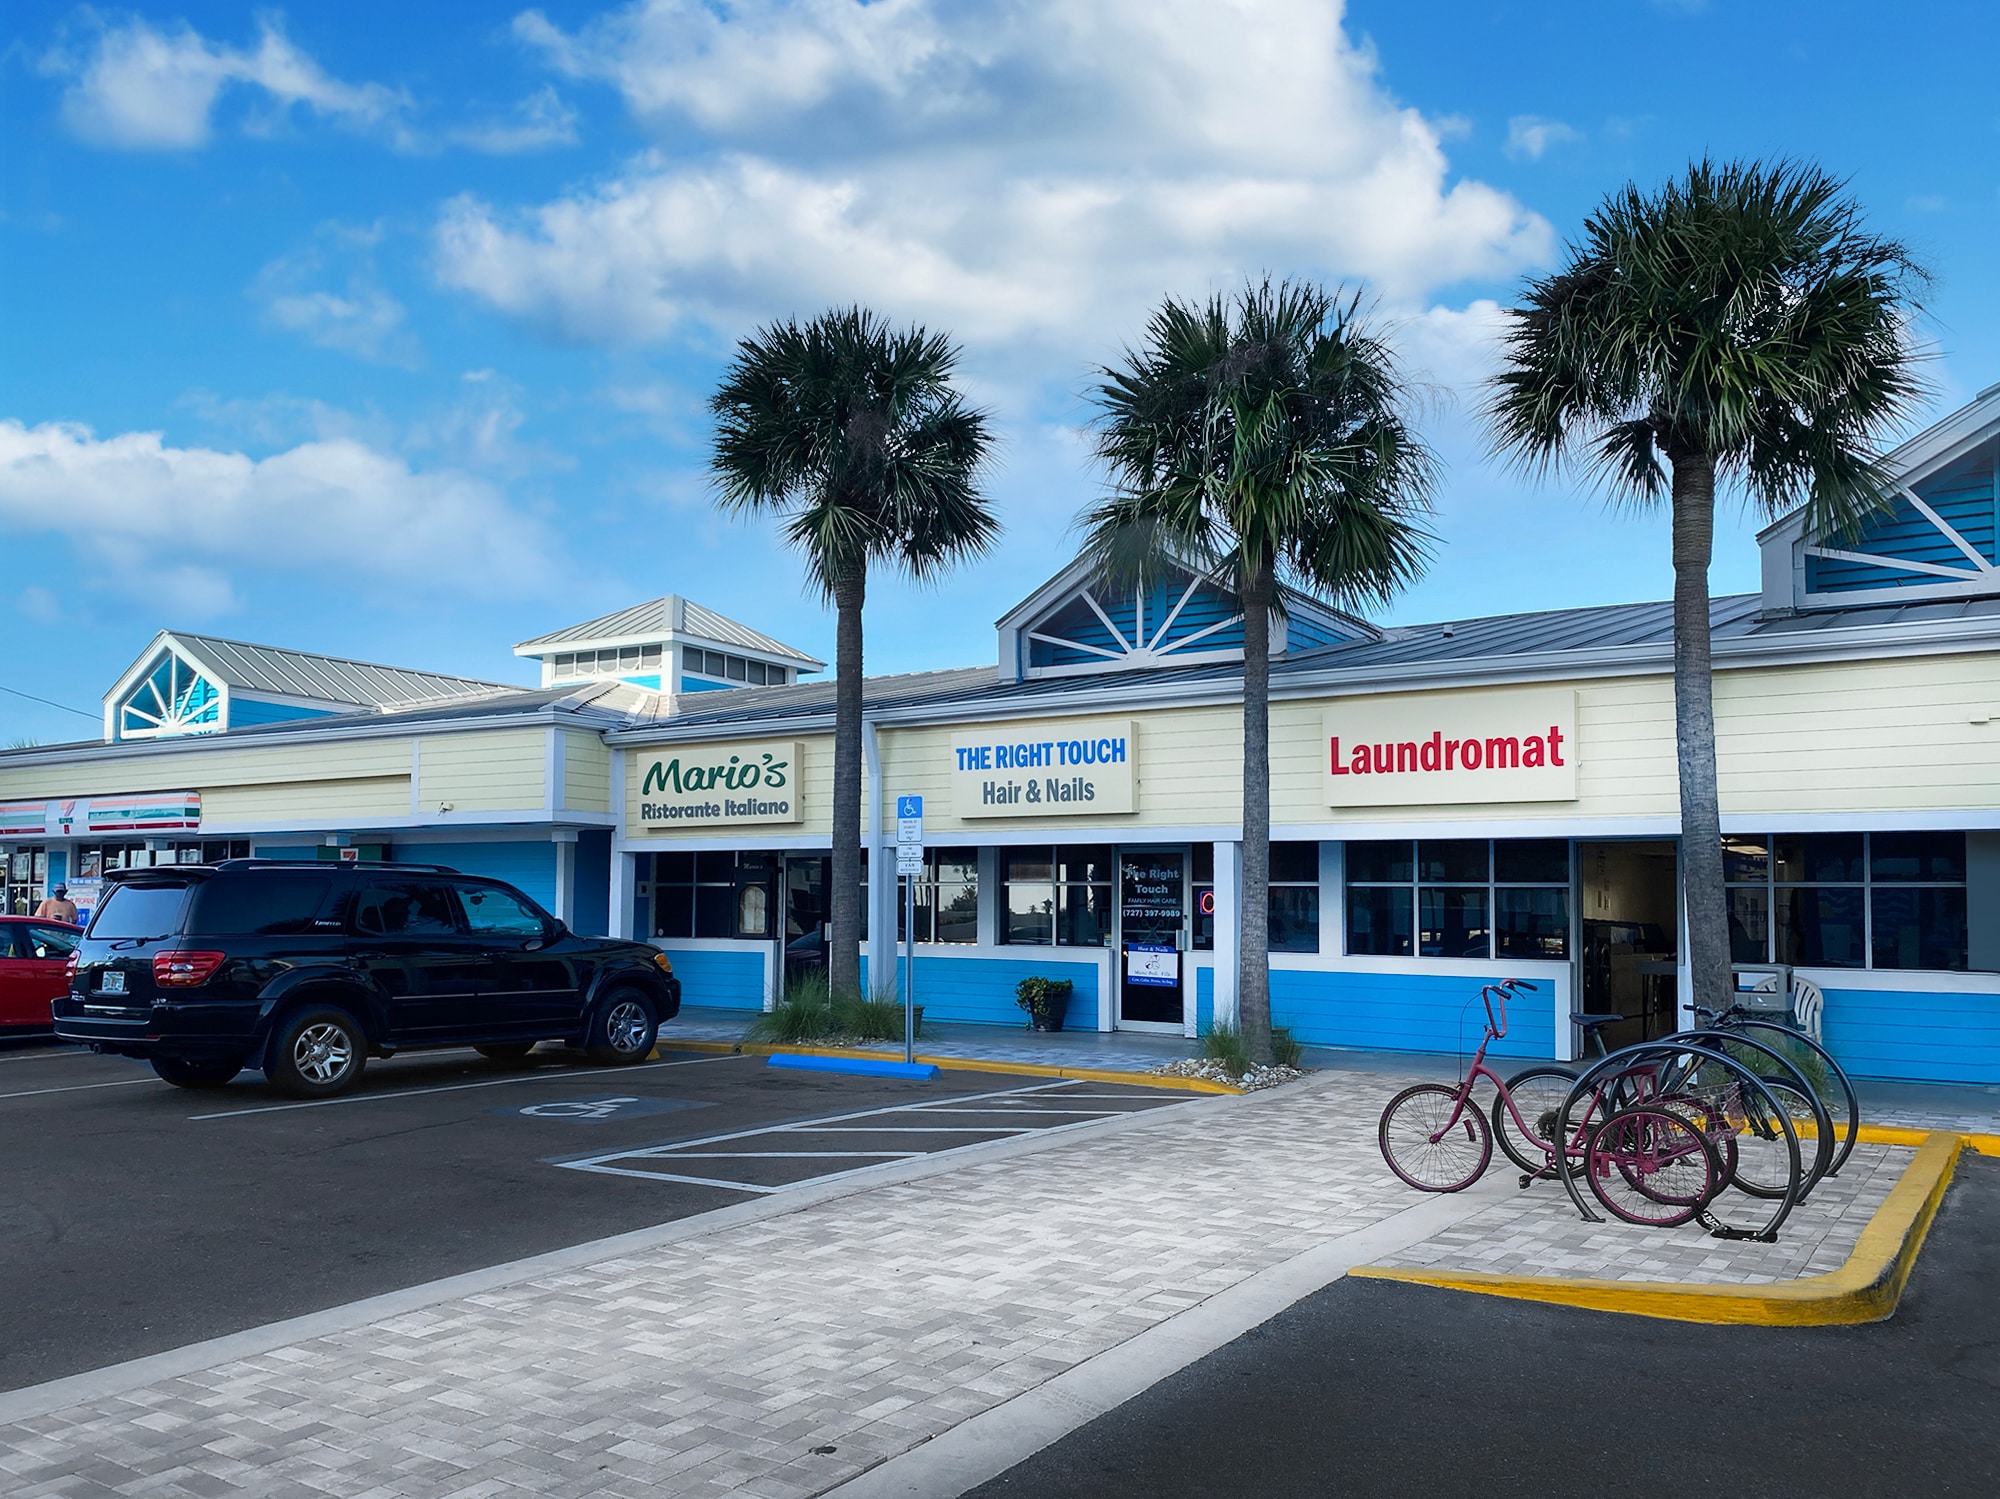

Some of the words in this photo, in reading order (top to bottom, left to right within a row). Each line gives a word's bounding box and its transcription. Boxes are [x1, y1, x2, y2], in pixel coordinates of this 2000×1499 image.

[955, 746, 992, 771] THE
[995, 742, 1054, 769] RIGHT
[1056, 737, 1126, 766] TOUCH
[1330, 725, 1565, 776] Laundromat
[641, 753, 789, 796] Mario's
[982, 780, 1022, 805] Hair
[1025, 779, 1041, 804] &
[1046, 776, 1095, 803] Nails
[641, 801, 721, 820] Ristorante
[724, 798, 789, 817] Italiano
[1149, 869, 1180, 881] Right
[1134, 884, 1169, 894] Touch
[1122, 908, 1143, 918] (727)
